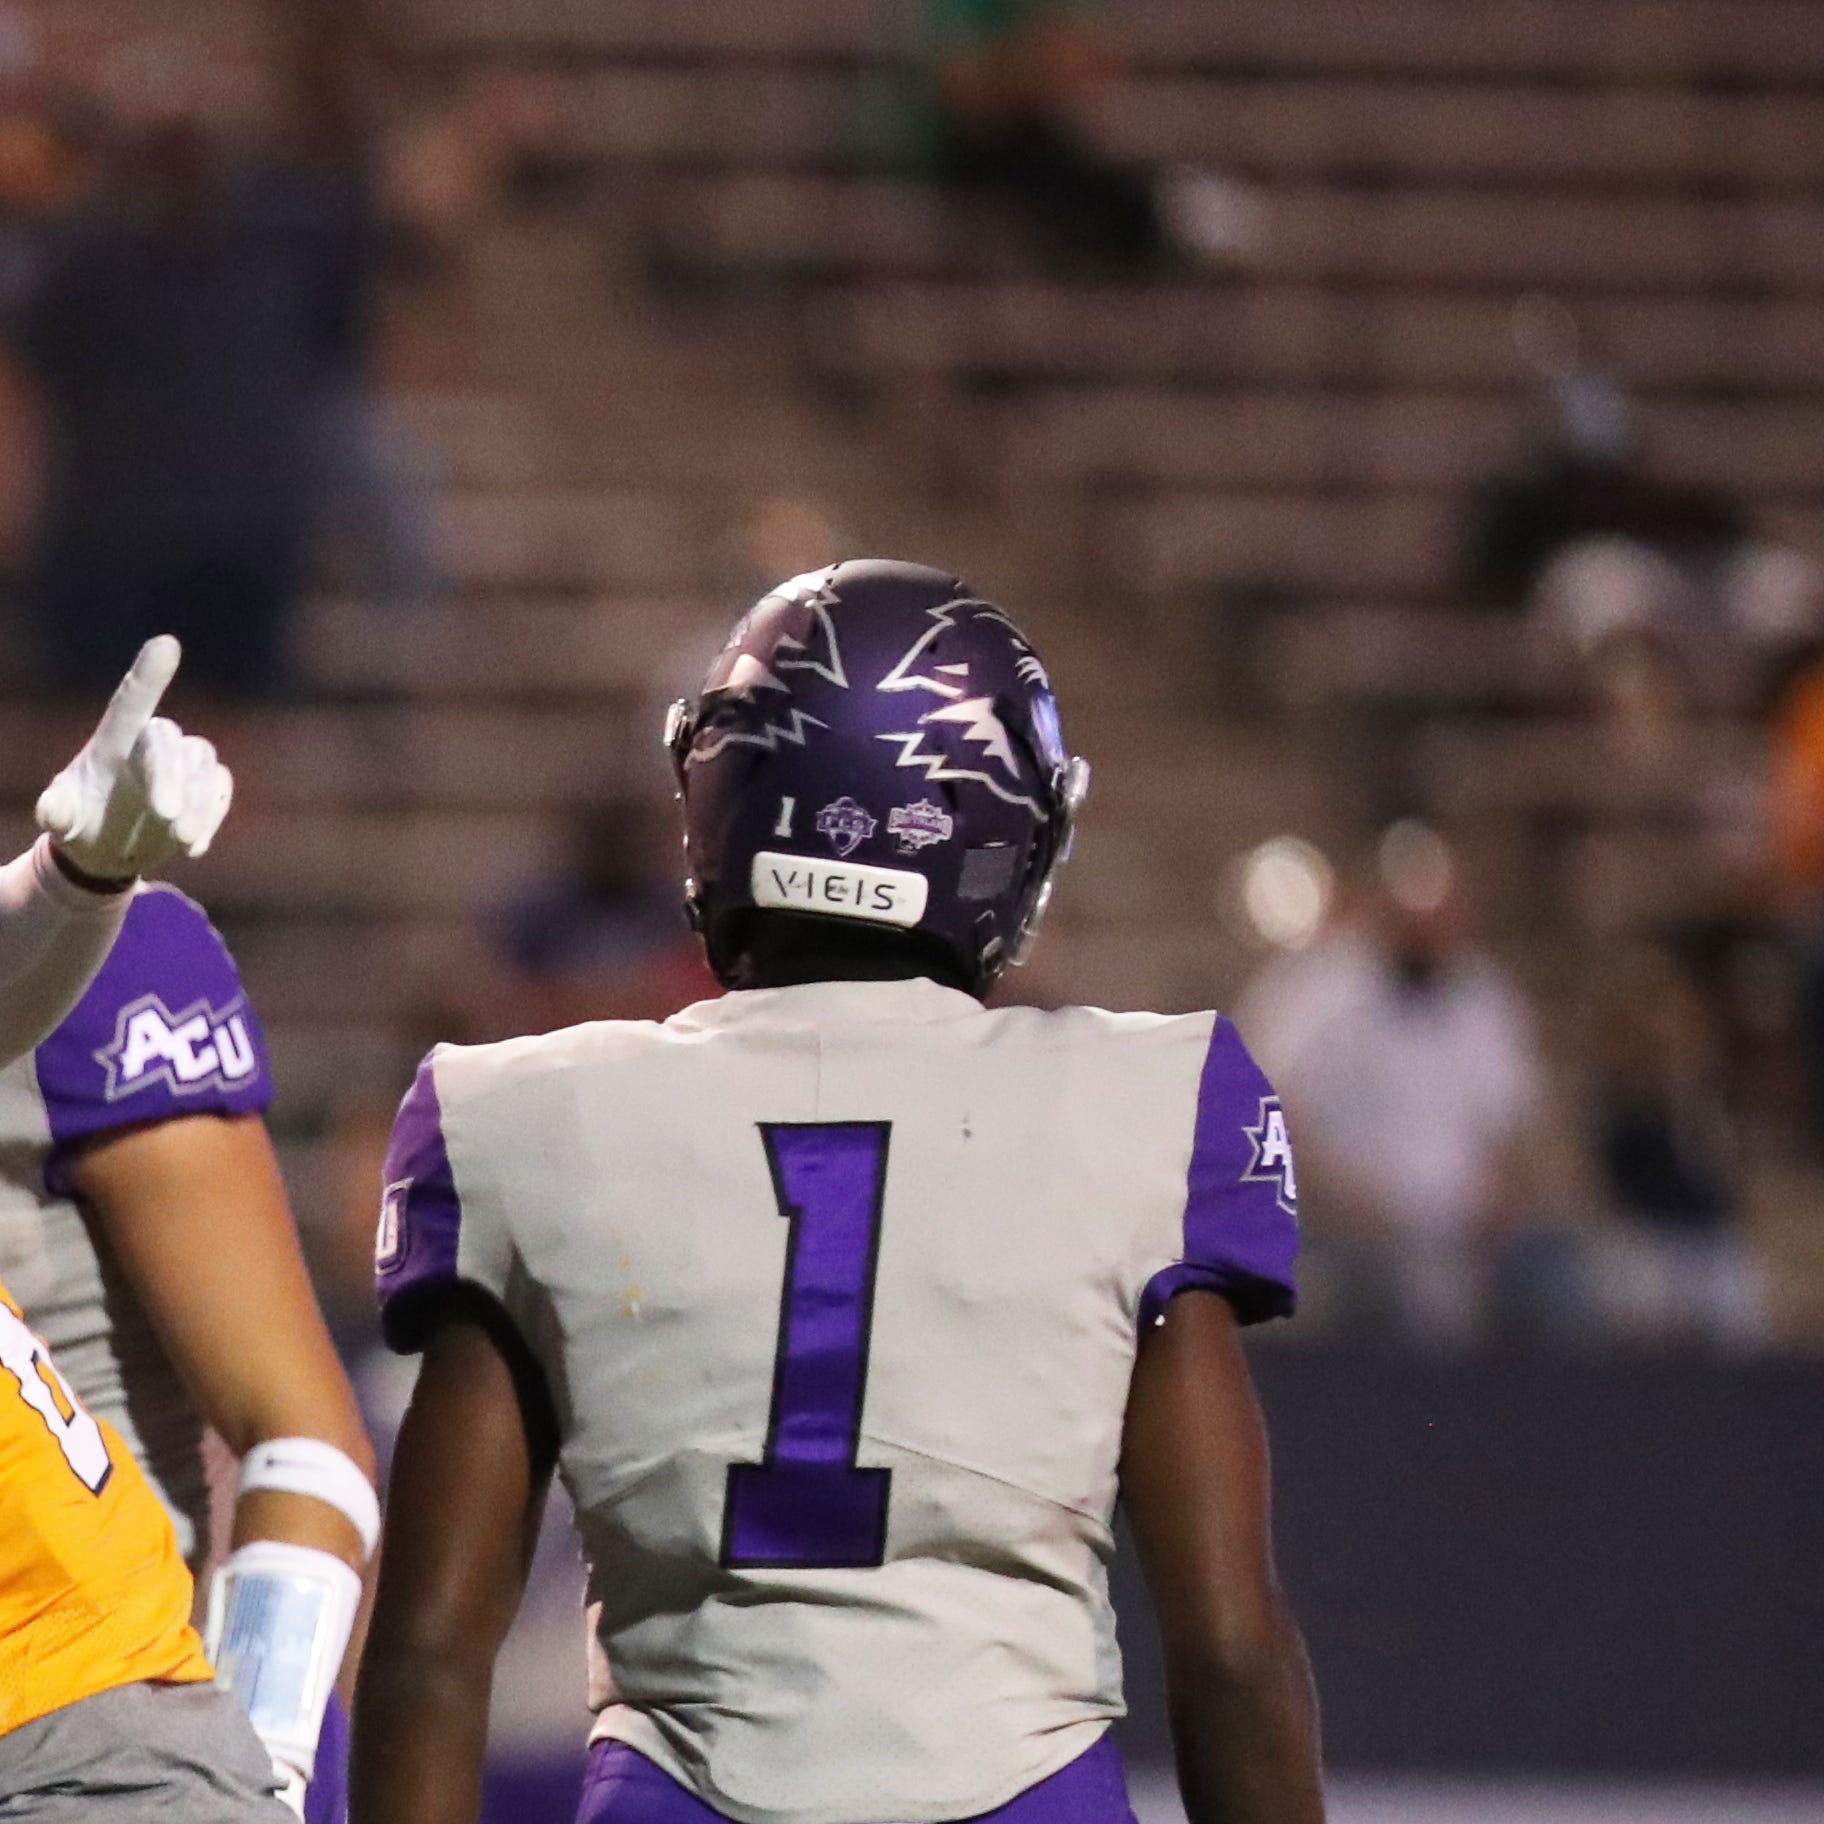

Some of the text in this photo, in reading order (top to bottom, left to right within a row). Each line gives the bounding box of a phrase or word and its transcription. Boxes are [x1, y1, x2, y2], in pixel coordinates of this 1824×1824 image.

[774, 796, 795, 838] 1
[120, 1008, 253, 1081] ACU
[718, 1120, 893, 1569] 1
